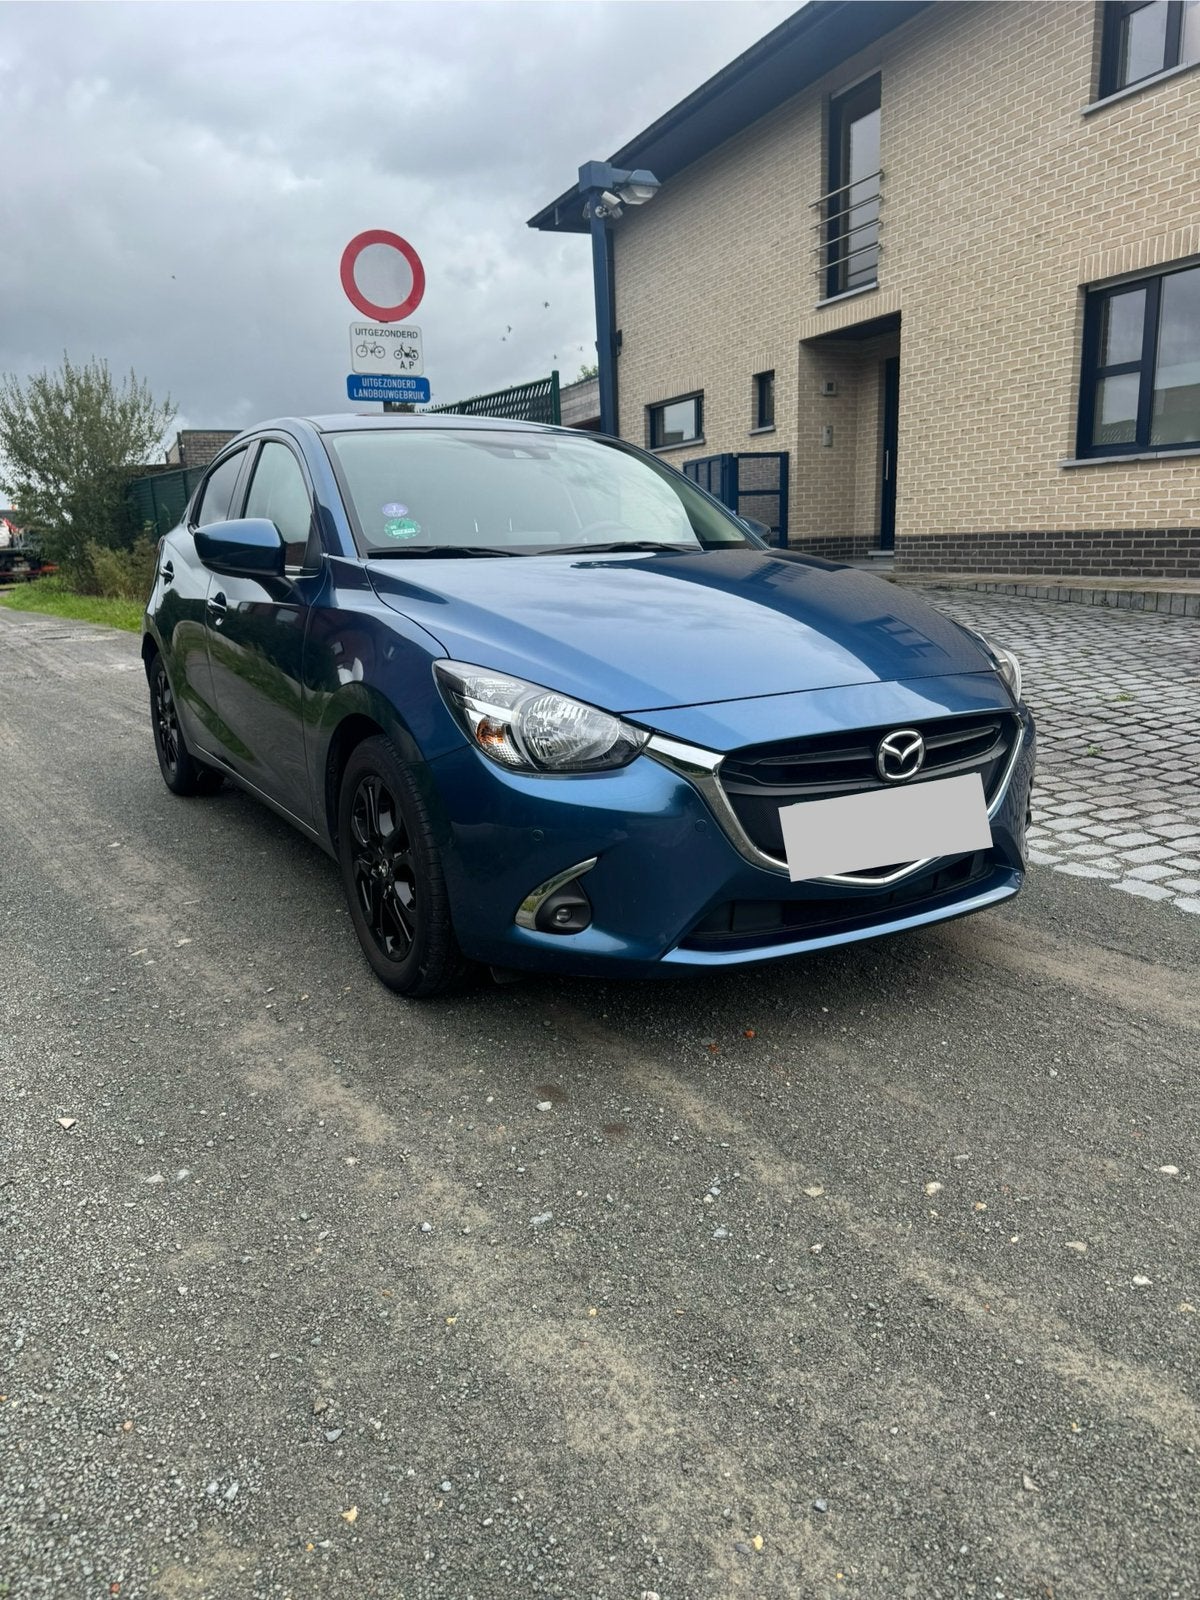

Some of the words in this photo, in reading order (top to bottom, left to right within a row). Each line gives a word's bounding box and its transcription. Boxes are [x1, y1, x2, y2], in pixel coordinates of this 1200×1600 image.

[355, 328, 418, 339] UITGEZONDERD
[362, 377, 416, 388] UITGEZONDERD
[354, 389, 425, 400] LANDBOUWGEBRUIK
